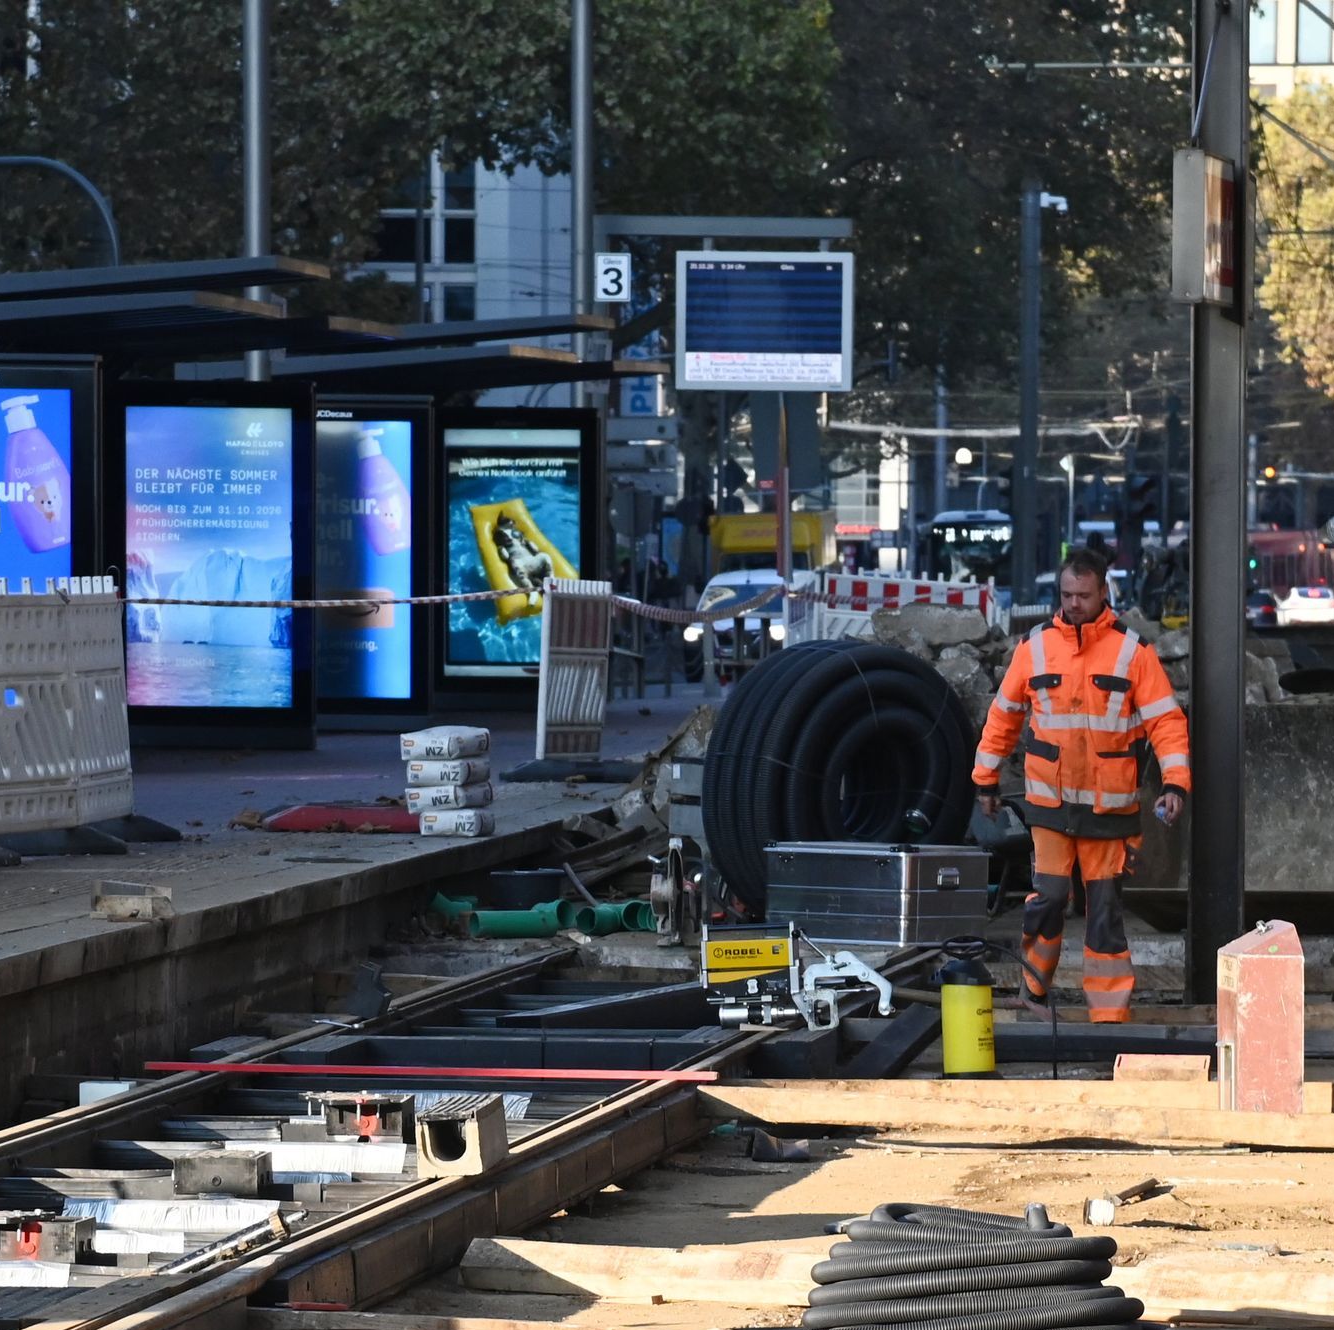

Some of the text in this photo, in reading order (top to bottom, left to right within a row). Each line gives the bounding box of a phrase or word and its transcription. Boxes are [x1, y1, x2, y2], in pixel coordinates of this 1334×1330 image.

[602, 267, 623, 296] 3
[135, 467, 277, 481] DER NÄCHSTE SOMMER
[491, 469, 533, 477] Notebook
[135, 482, 262, 495] BLEIBT FÜR IMMER
[135, 504, 161, 513] NOCH
[167, 504, 186, 513] BIS
[192, 505, 212, 514] ZUM
[724, 947, 763, 956] ROBEL
